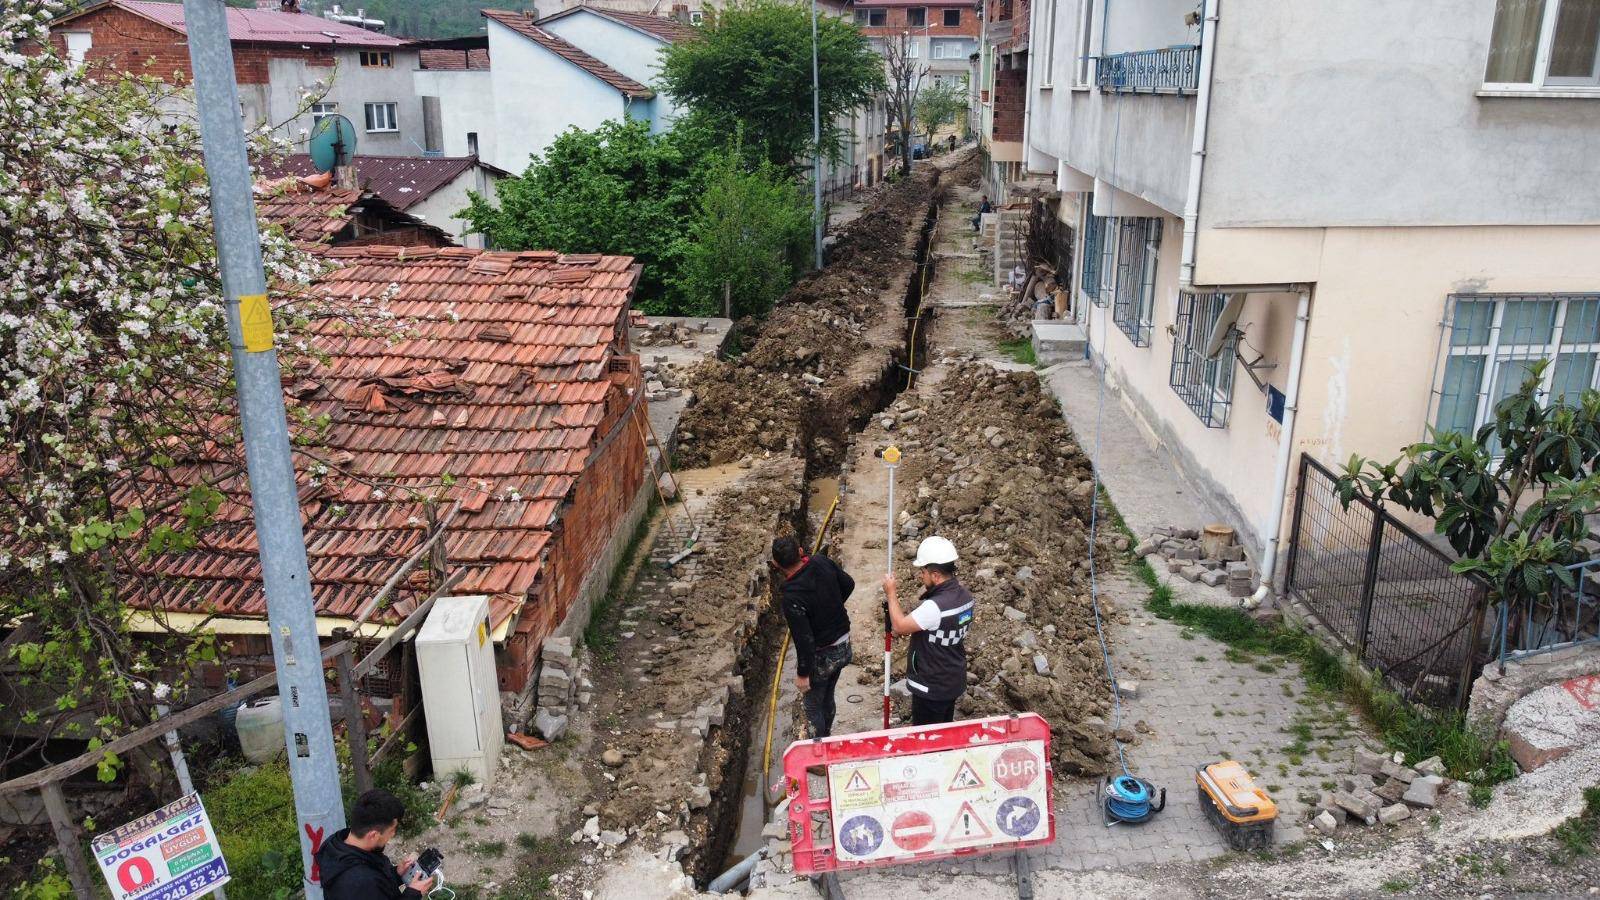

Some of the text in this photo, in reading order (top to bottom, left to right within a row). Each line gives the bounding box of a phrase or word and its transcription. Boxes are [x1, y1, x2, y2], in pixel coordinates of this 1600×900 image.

[997, 760, 1035, 778] DUR
[104, 814, 204, 867] DOĞALGAZ
[164, 832, 201, 854] UYGUN
[117, 856, 155, 894] 0
[189, 875, 207, 891] 52
[208, 865, 225, 881] 34
